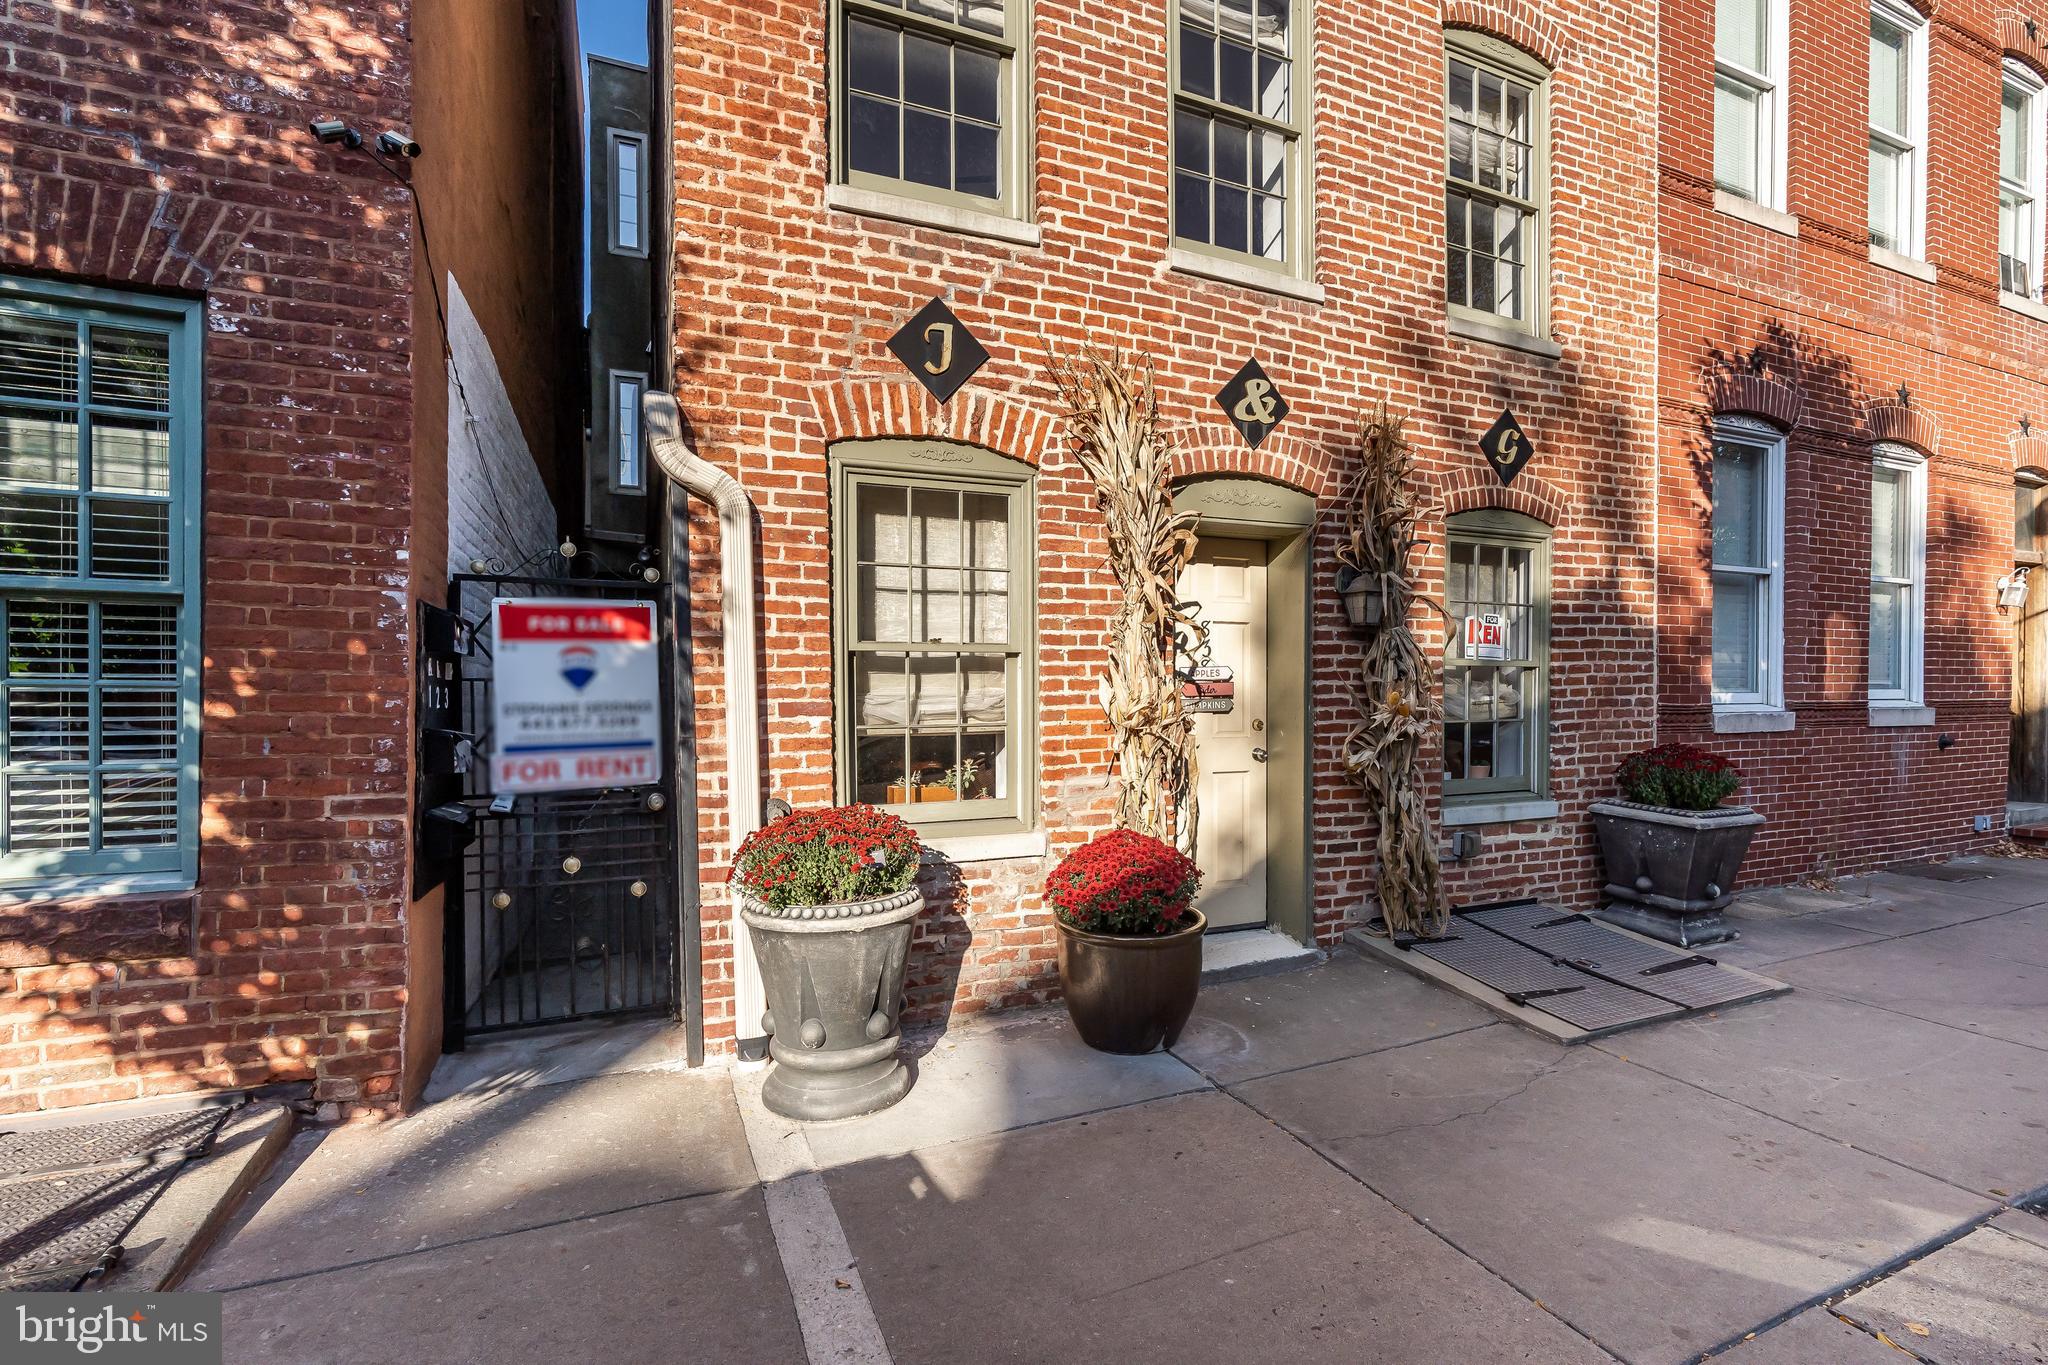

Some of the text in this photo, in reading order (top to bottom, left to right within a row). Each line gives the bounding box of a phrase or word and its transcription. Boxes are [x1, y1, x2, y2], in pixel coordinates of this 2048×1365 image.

[924, 322, 1521, 465] J & G
[527, 616, 625, 632] FOR SALE
[1468, 618, 1509, 645] REN
[1193, 668, 1221, 678] PPLES
[503, 755, 647, 784] FOR RENT
